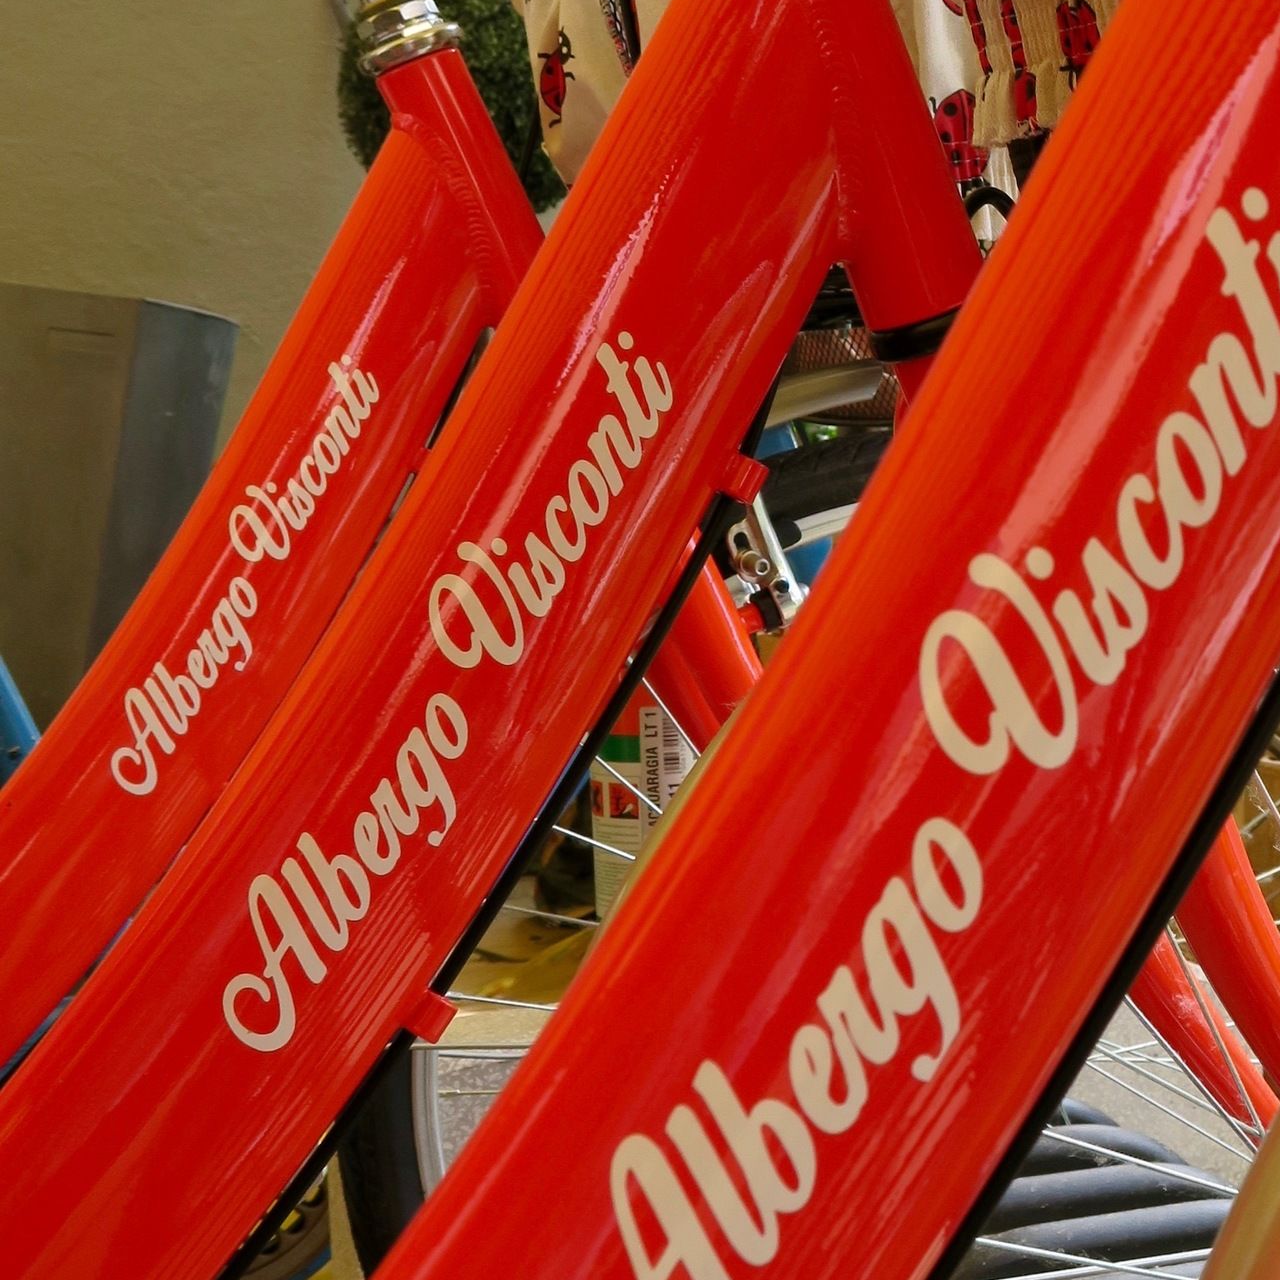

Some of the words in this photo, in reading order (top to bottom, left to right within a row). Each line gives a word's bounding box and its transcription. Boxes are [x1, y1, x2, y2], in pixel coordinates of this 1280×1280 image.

[111, 576, 258, 796] Albergo
[228, 354, 380, 563] Visconti
[222, 693, 469, 1053] Albergo
[428, 330, 674, 670] Visconti
[645, 723, 658, 738] LT
